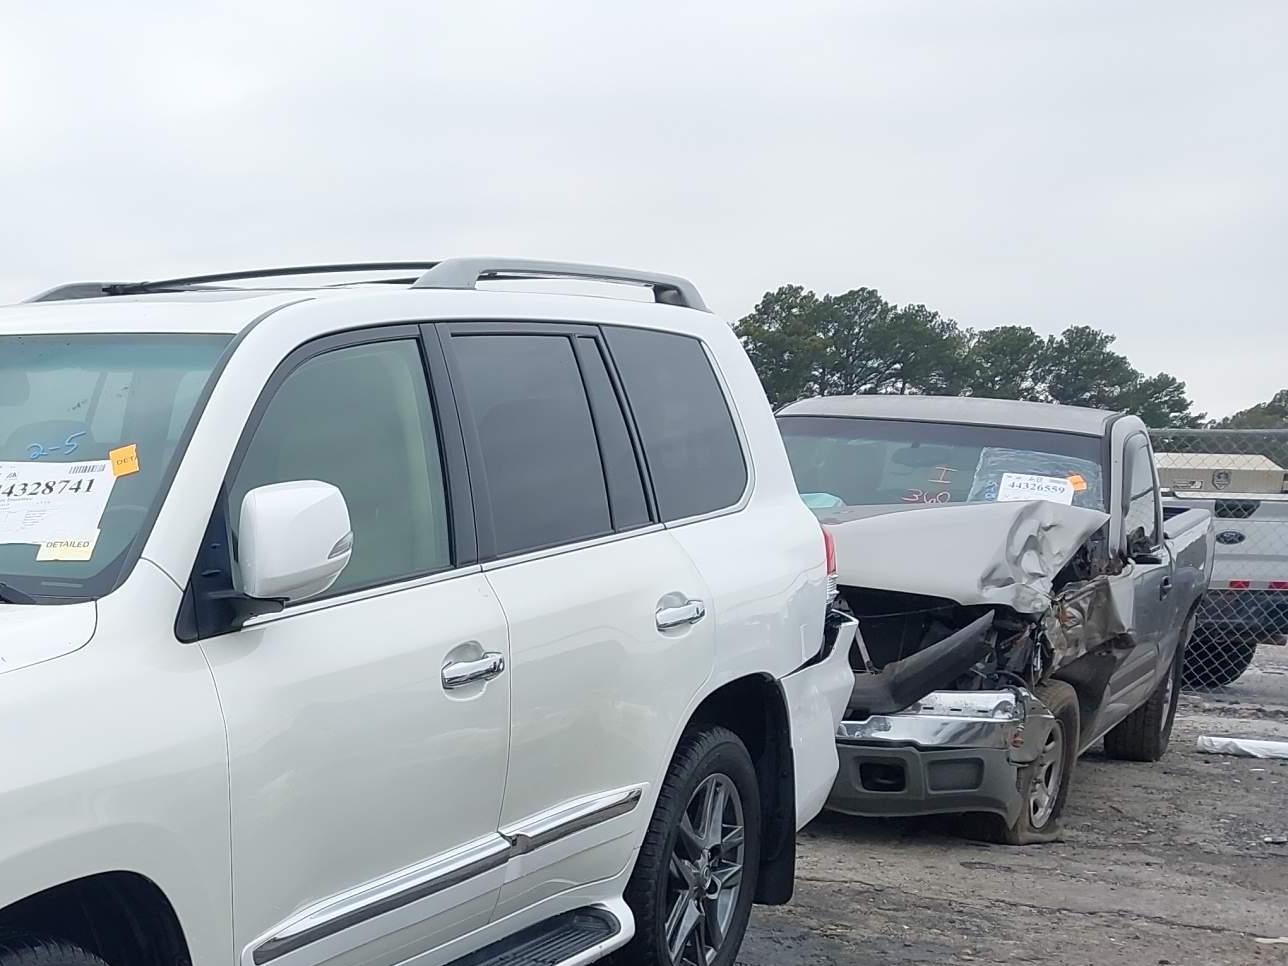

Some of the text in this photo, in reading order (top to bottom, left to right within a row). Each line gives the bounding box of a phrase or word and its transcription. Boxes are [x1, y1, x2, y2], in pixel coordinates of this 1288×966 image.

[27, 431, 87, 460] 2-5
[1008, 481, 1065, 493] 44326559
[46, 540, 90, 548] DETAILED
